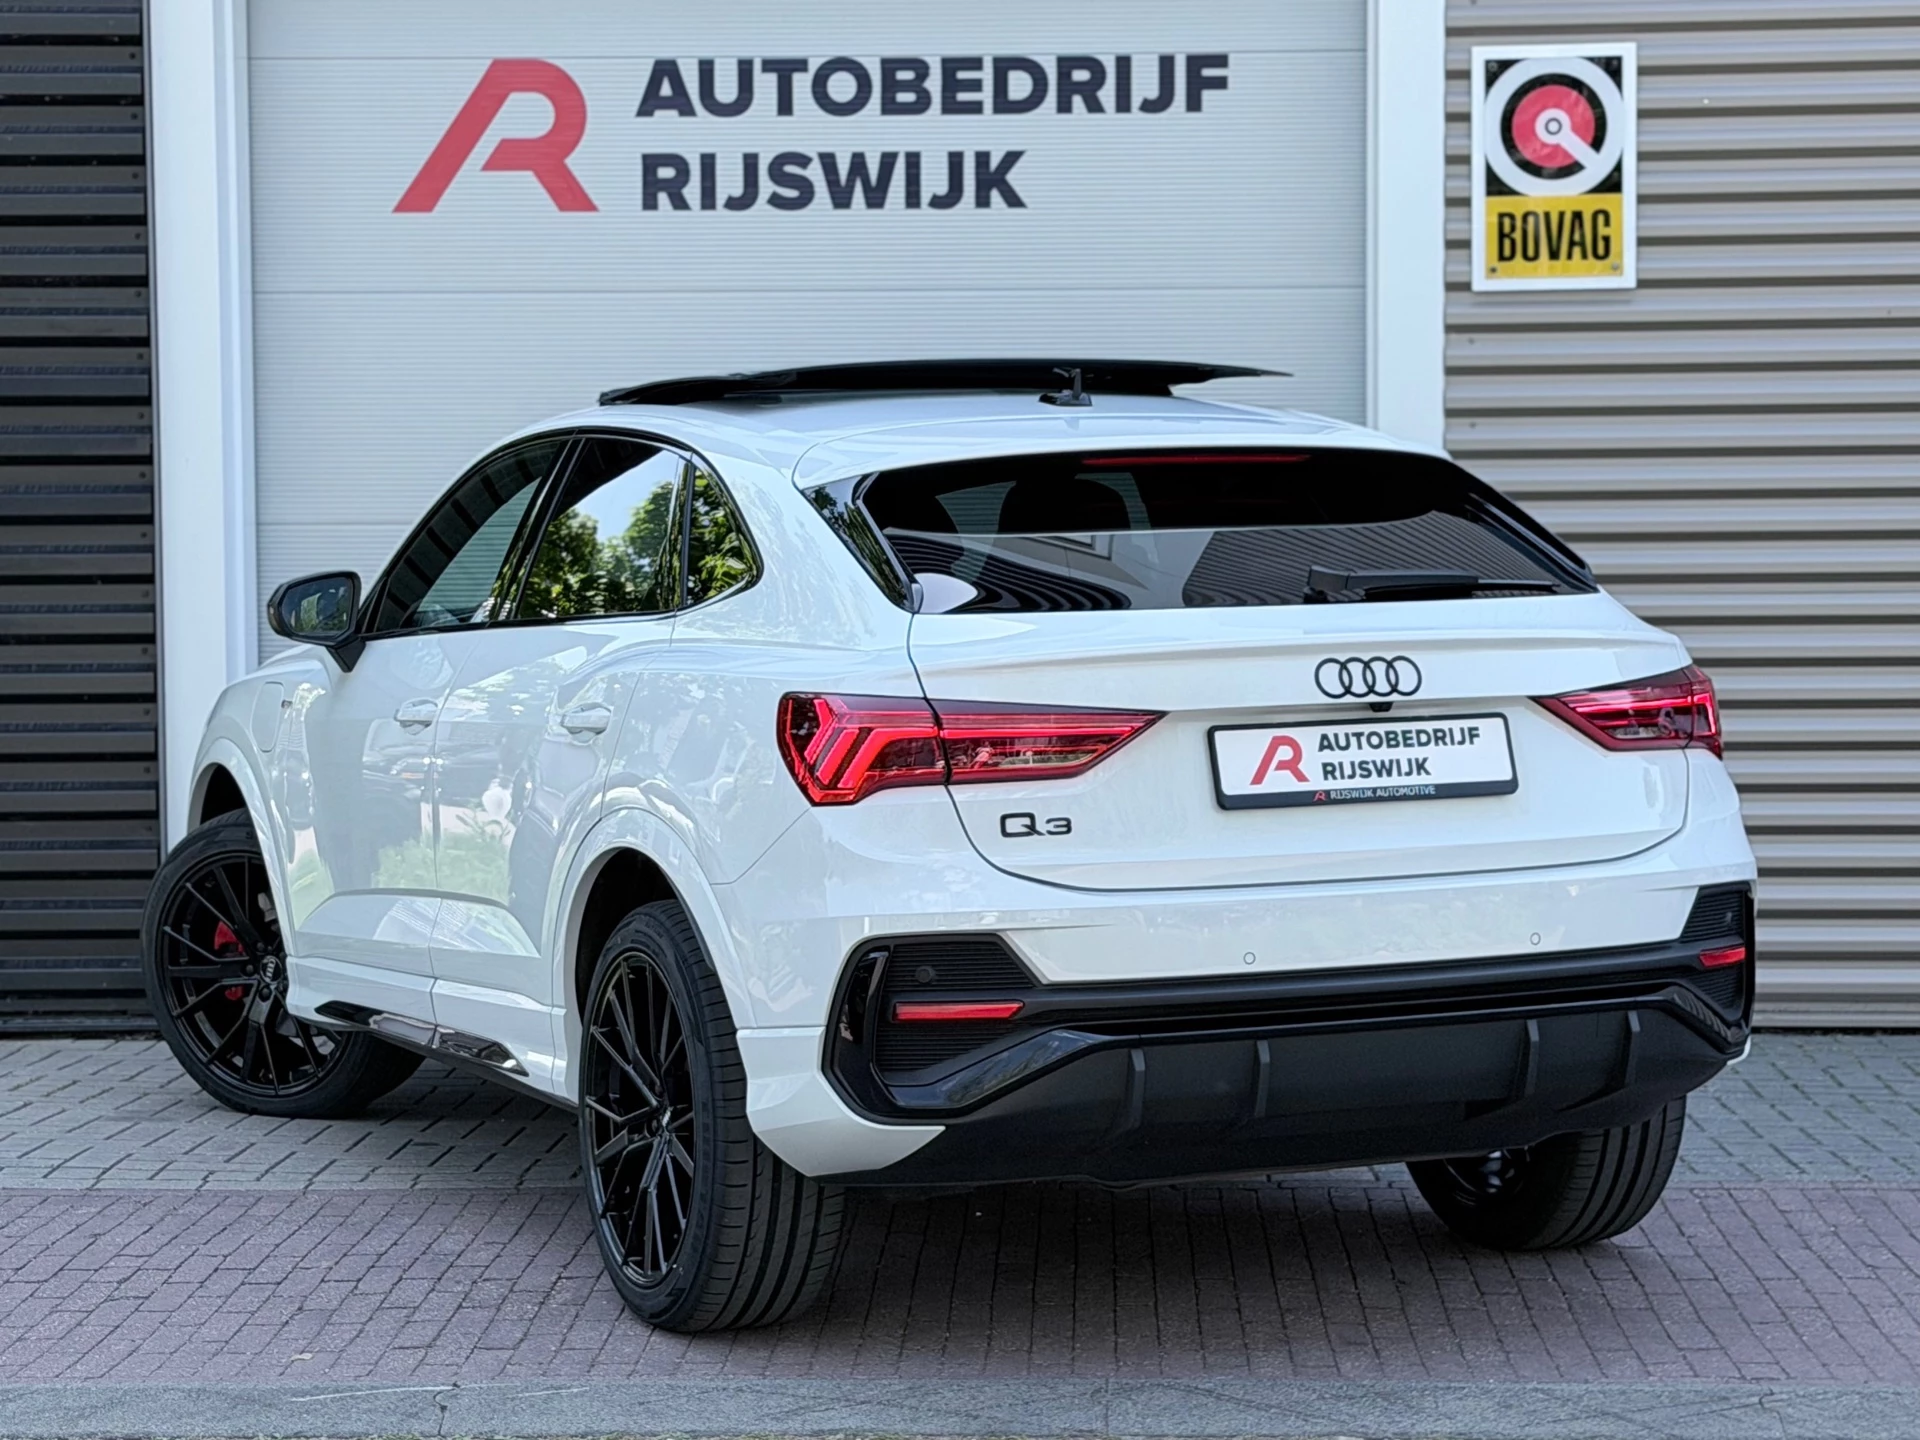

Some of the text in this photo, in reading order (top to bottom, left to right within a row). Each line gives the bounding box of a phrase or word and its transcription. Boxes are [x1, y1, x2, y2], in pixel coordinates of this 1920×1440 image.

[635, 53, 1230, 119] AUTOBEDRIJF
[640, 150, 1028, 212] RIJSWIJK
[1497, 208, 1612, 263] BOVAG
[1317, 726, 1480, 753] AUTOBEDRIJF
[1321, 757, 1432, 781] RIJSWIJK
[1330, 788, 1374, 800] RIJSWIJK
[1376, 785, 1436, 798] AUTOMOTIVE
[999, 811, 1073, 838] Q3
